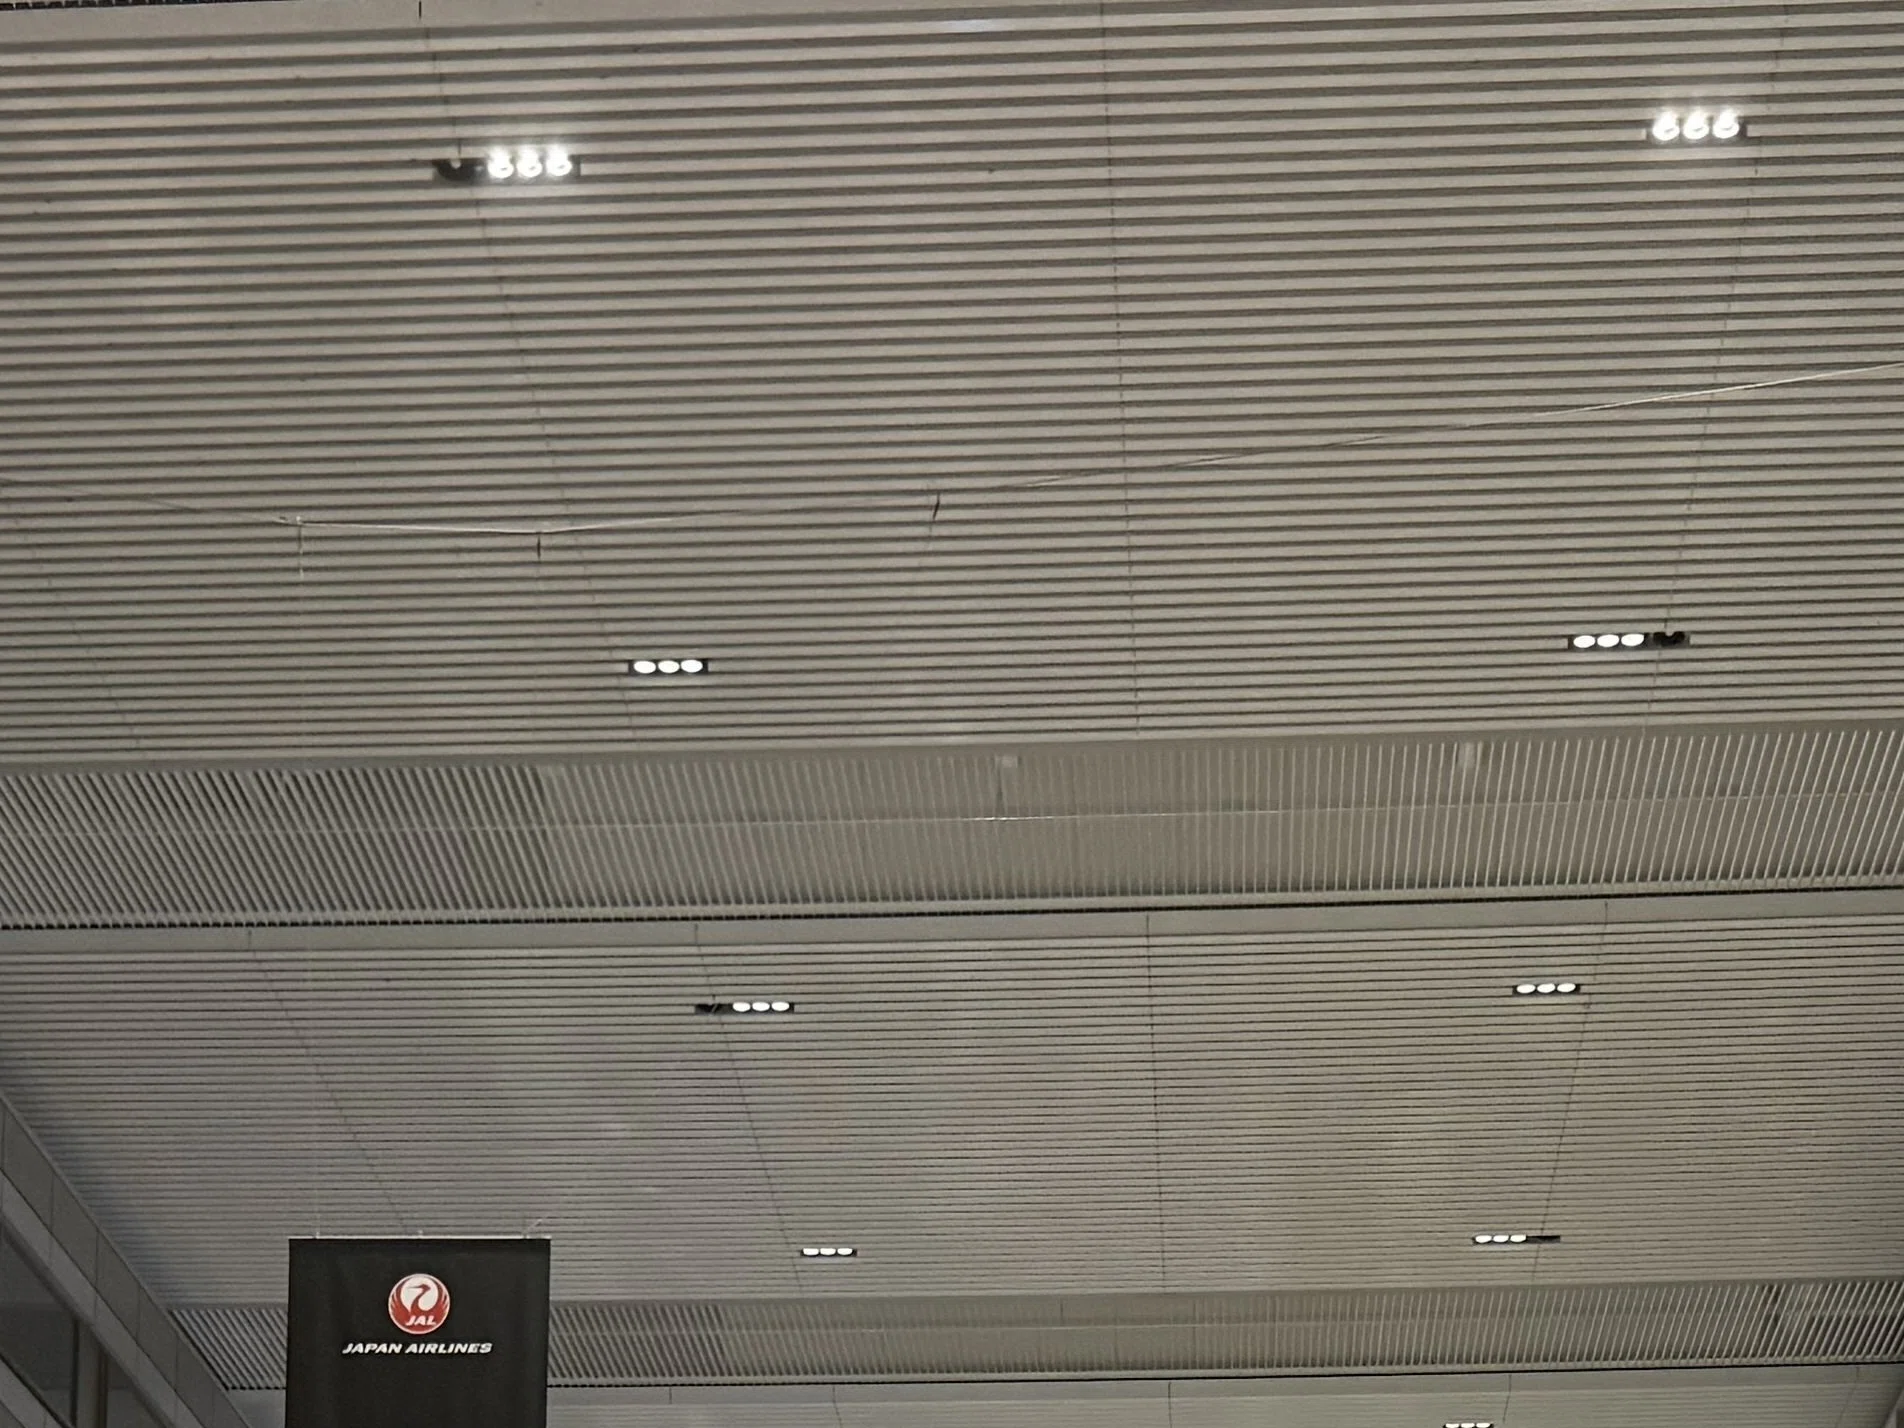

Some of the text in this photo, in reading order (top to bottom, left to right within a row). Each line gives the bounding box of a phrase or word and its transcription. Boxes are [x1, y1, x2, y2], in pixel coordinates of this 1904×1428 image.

[405, 1315, 437, 1327] JAL
[342, 1343, 493, 1354] JAPAN AIRLINES
